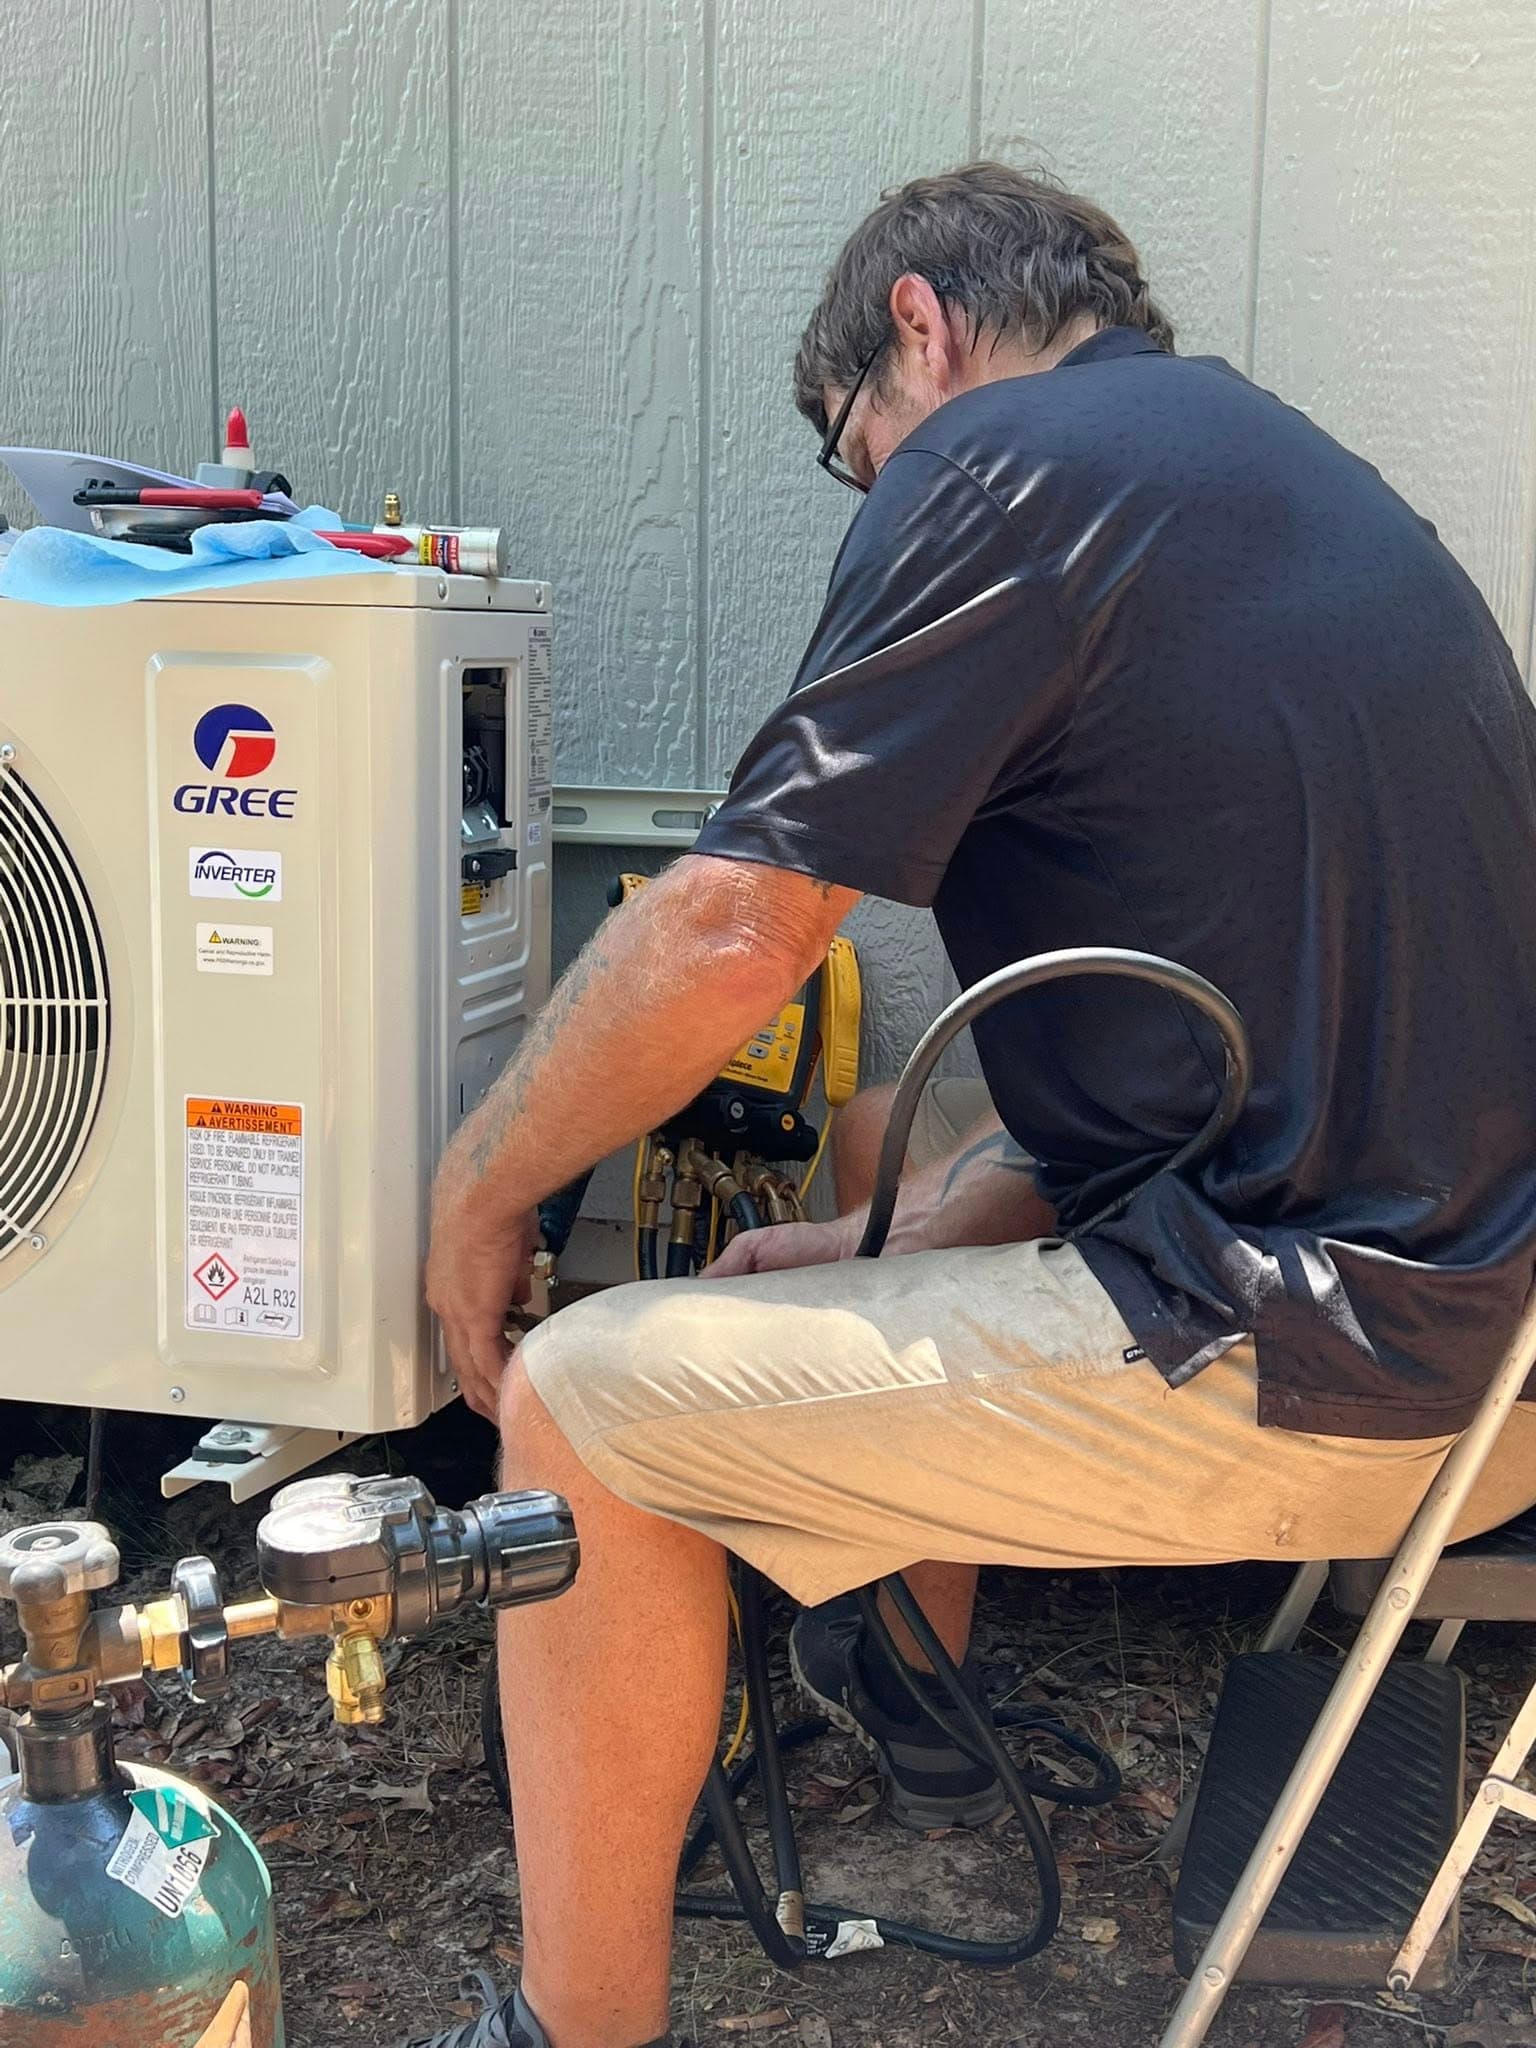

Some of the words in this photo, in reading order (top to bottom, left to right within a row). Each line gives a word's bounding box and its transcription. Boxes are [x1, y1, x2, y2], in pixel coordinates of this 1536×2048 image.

[173, 784, 299, 819] GREE
[194, 865, 276, 884] INVERTER
[224, 1103, 278, 1118] WARNING
[209, 1116, 293, 1133] AVERTISSEMENT
[189, 1130, 201, 1140] RISK
[204, 1131, 211, 1141] OF
[228, 1133, 259, 1144] FLAMMABLE
[262, 1135, 299, 1147] REFRIGERANT
[207, 1145, 214, 1156] TO
[216, 1146, 223, 1156] BE
[225, 1147, 250, 1158] REPAIRED
[253, 1149, 266, 1160] ONLY
[267, 1150, 274, 1160] BY
[277, 1151, 298, 1162] TRAINED
[189, 1158, 212, 1170] SERVICE
[247, 1163, 256, 1174] DO
[258, 1164, 269, 1175] NOT
[270, 1165, 299, 1177] PUNCTURE
[189, 1172, 229, 1185] REFRIGERANT
[243, 1286, 269, 1306] A2L
[273, 1288, 296, 1308] R32
[125, 1832, 159, 1884] COMPRESSED
